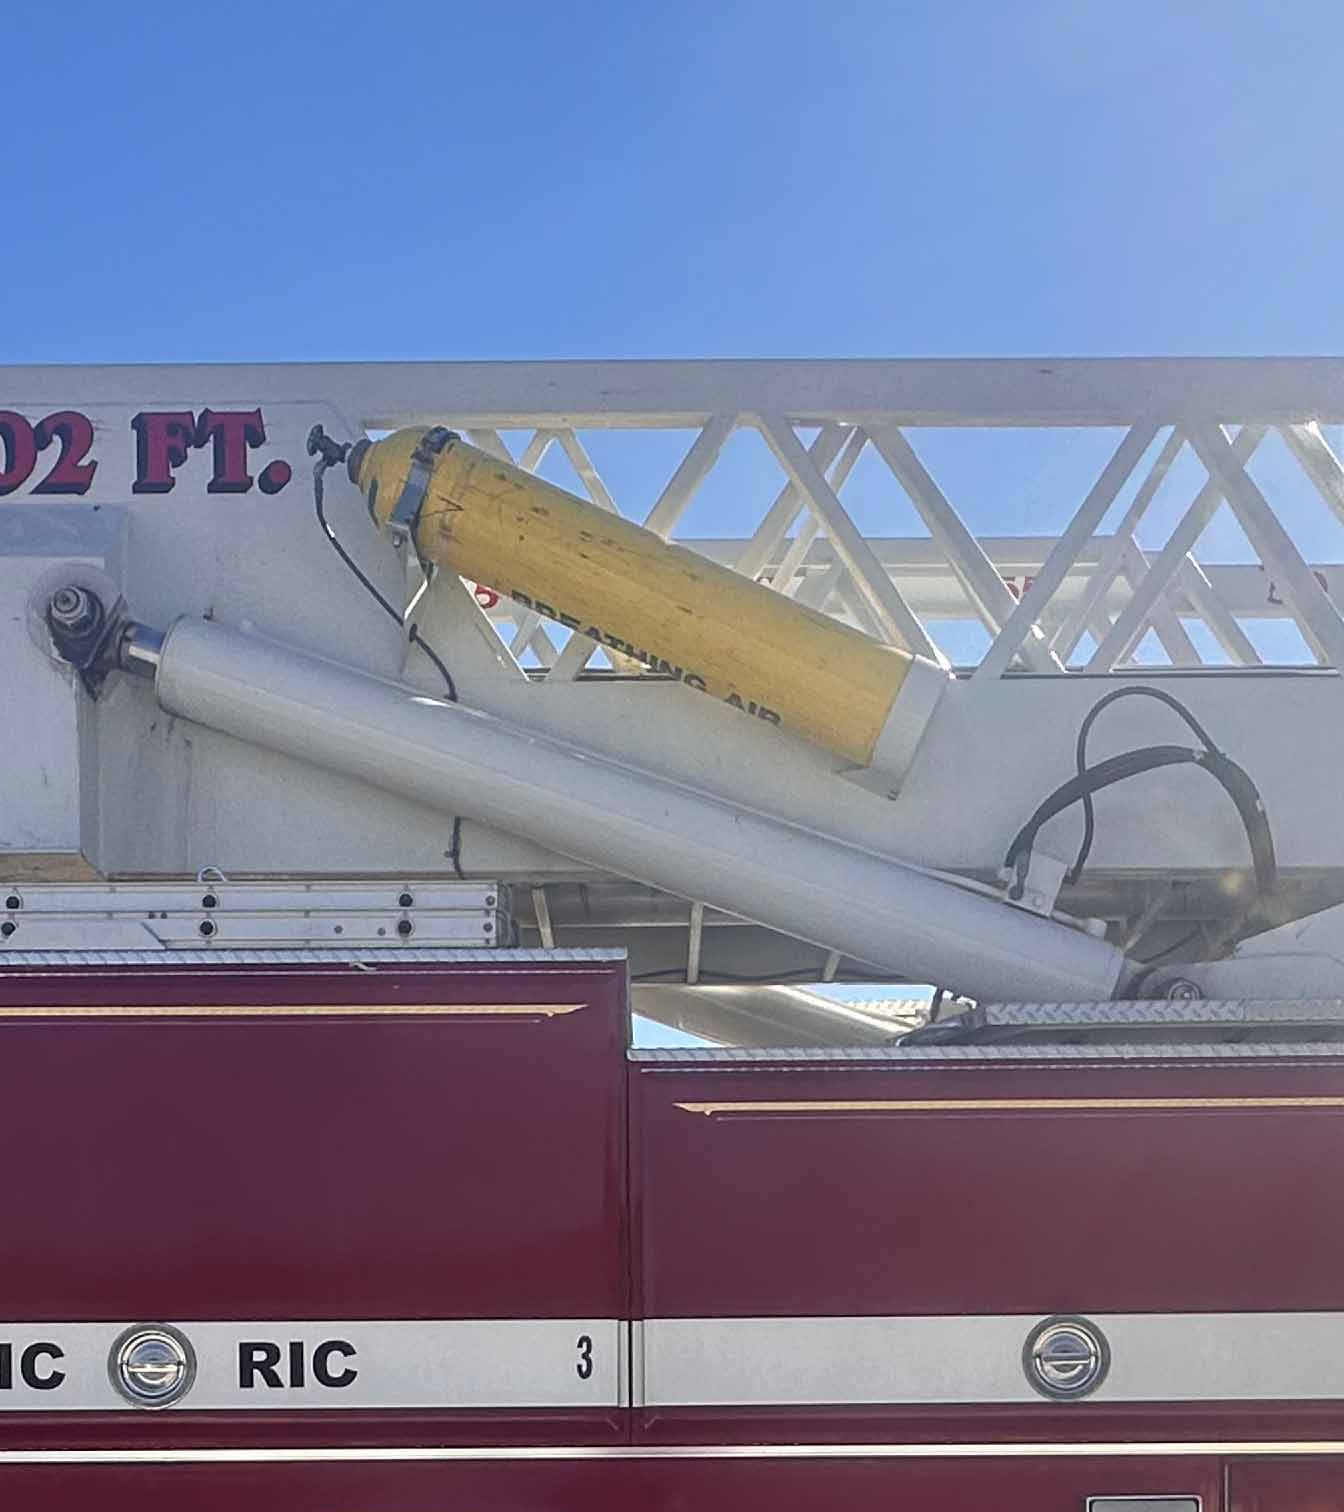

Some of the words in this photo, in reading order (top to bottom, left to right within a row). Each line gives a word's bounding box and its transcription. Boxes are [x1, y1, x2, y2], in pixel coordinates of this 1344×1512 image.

[131, 408, 292, 496] FT.
[238, 1340, 358, 1389] RIC
[576, 1335, 593, 1380] 3
